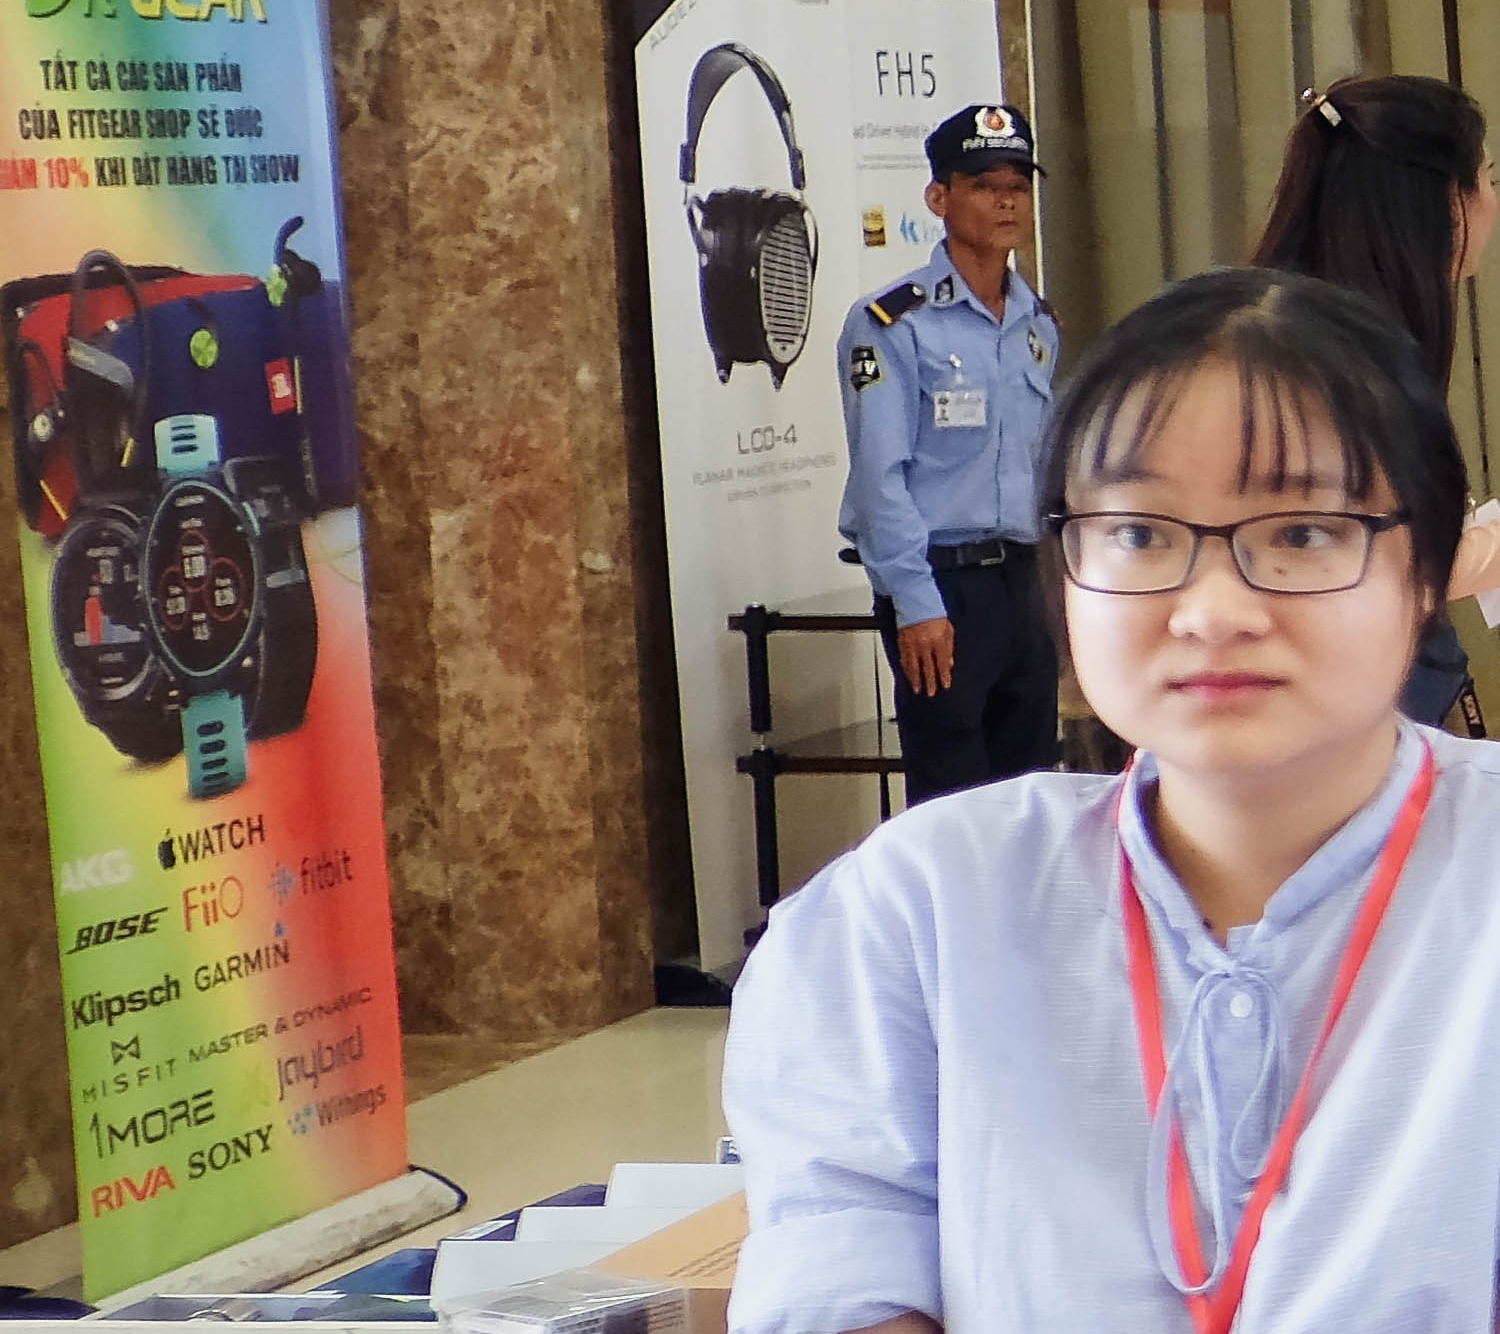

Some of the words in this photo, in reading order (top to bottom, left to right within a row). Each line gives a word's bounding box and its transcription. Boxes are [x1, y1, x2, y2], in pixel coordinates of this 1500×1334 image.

[874, 51, 937, 98] FH5
[44, 156, 89, 190] 10%
[95, 155, 126, 188] KHI
[178, 813, 266, 866] WATCH
[66, 906, 169, 956] BOSE
[183, 875, 245, 934] FiiO
[72, 974, 182, 1031] Klipsch
[194, 938, 292, 993] GARMIN
[81, 1057, 177, 1104] MISFIT
[189, 1022, 271, 1064] MASTER
[293, 987, 373, 1029] DYNAMIC
[88, 1088, 216, 1161] 1MORE
[90, 1164, 177, 1219] RIVA
[188, 1123, 274, 1181] SONY
